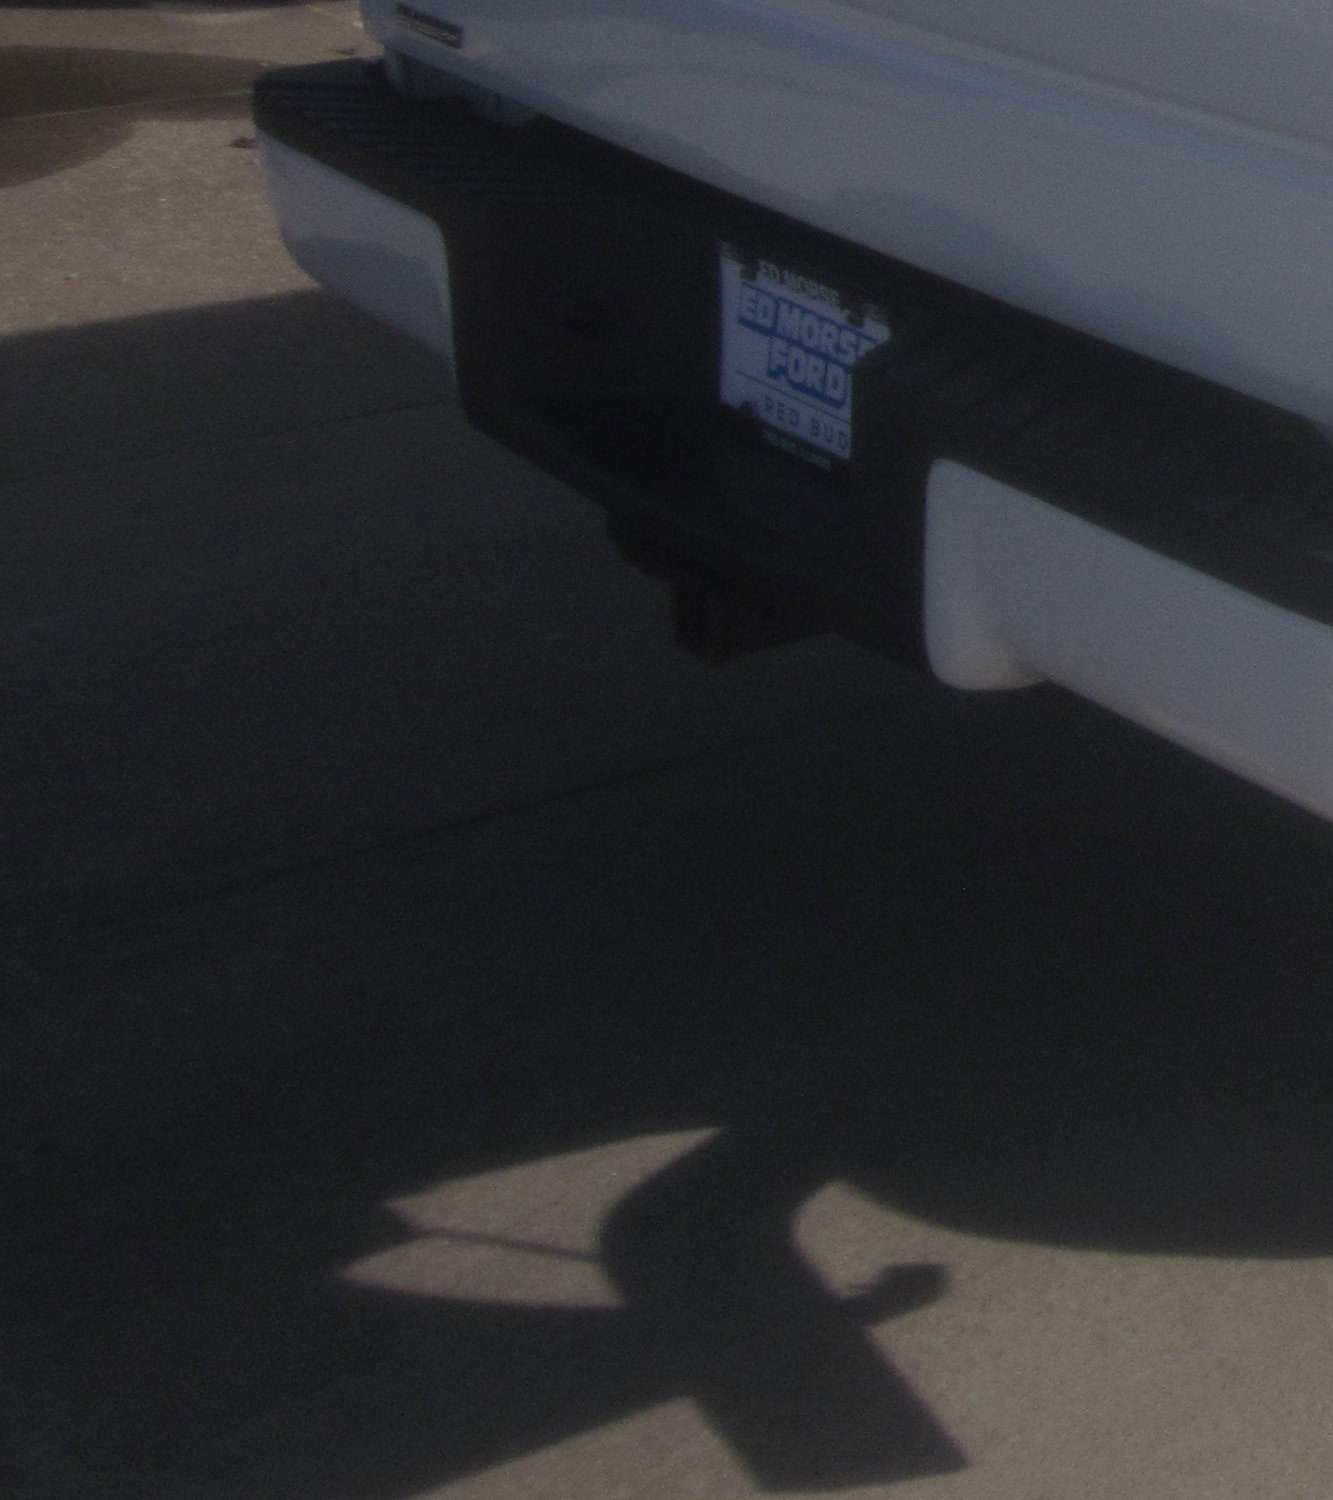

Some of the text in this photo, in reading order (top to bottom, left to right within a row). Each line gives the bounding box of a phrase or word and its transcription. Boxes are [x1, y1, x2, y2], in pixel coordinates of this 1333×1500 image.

[740, 285, 776, 330] ED
[768, 336, 847, 404] FORD
[763, 395, 801, 428] RED
